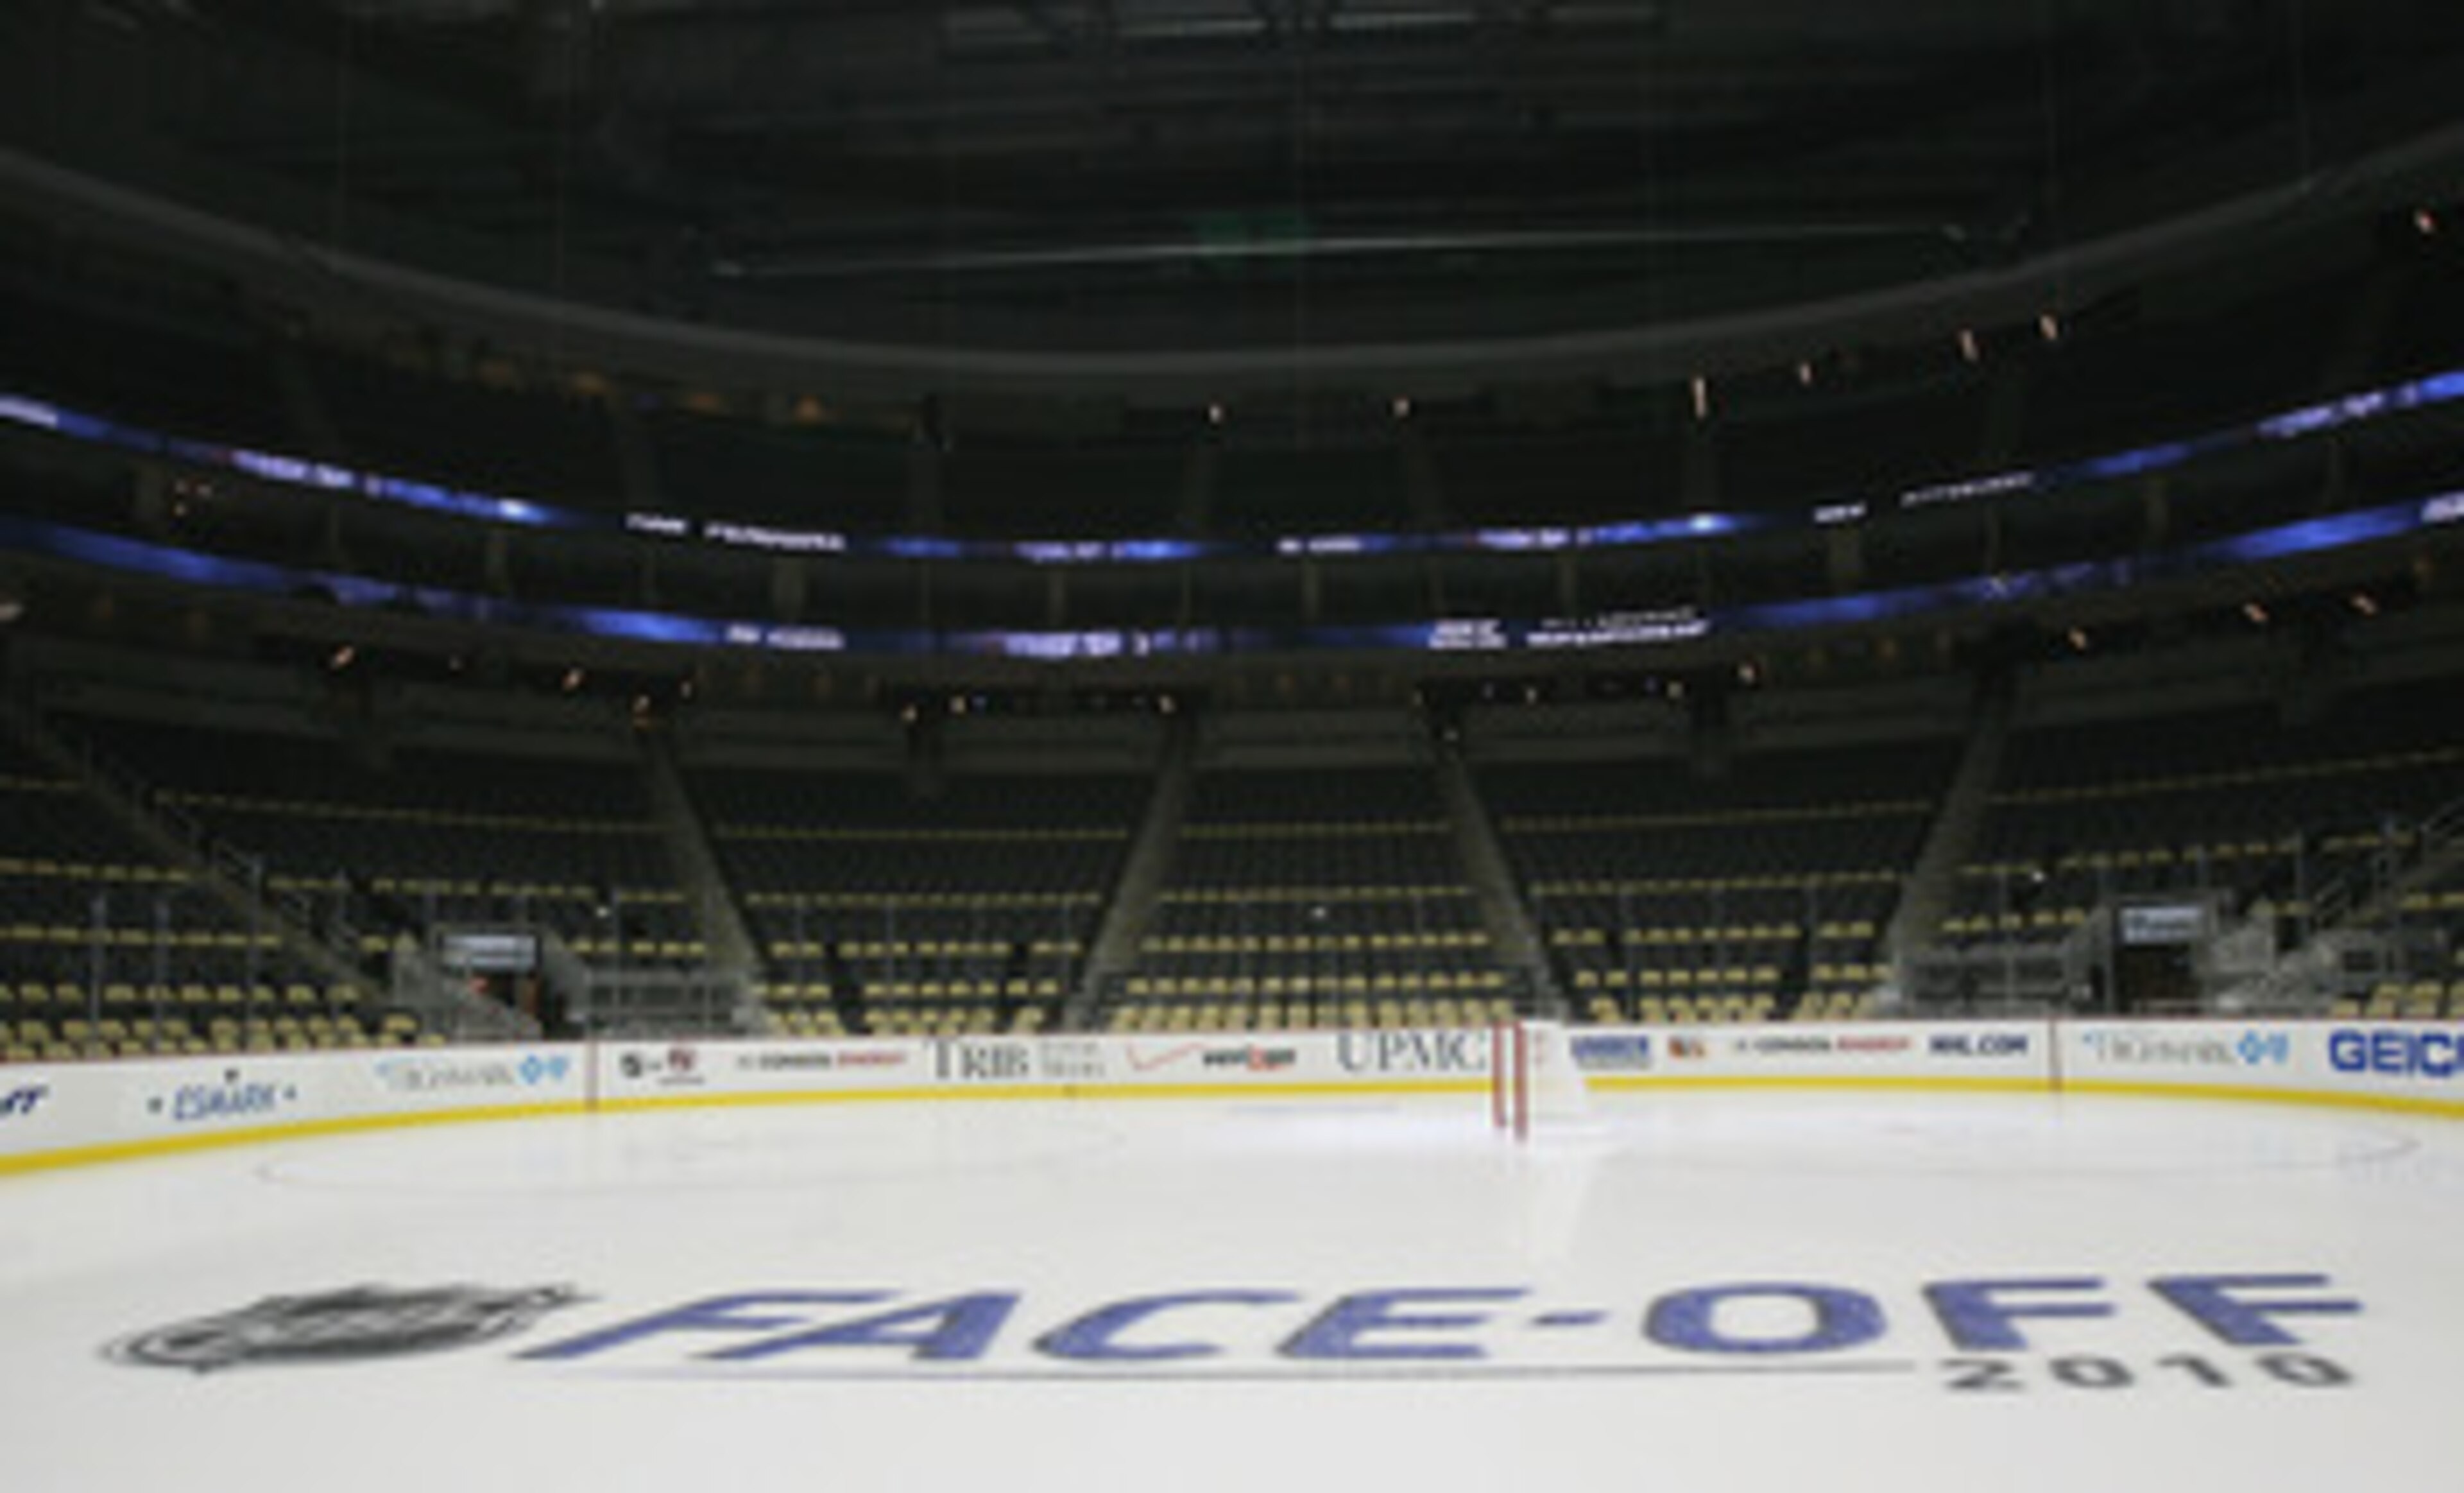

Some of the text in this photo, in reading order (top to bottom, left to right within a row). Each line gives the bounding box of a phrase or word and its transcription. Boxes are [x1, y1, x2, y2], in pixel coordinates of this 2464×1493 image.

[1336, 1030, 1487, 1073] UPMC
[2328, 1028, 2464, 1078] GEIC
[509, 1273, 2364, 1360] FACE-OFF
[1938, 1356, 2357, 1391] 2010
